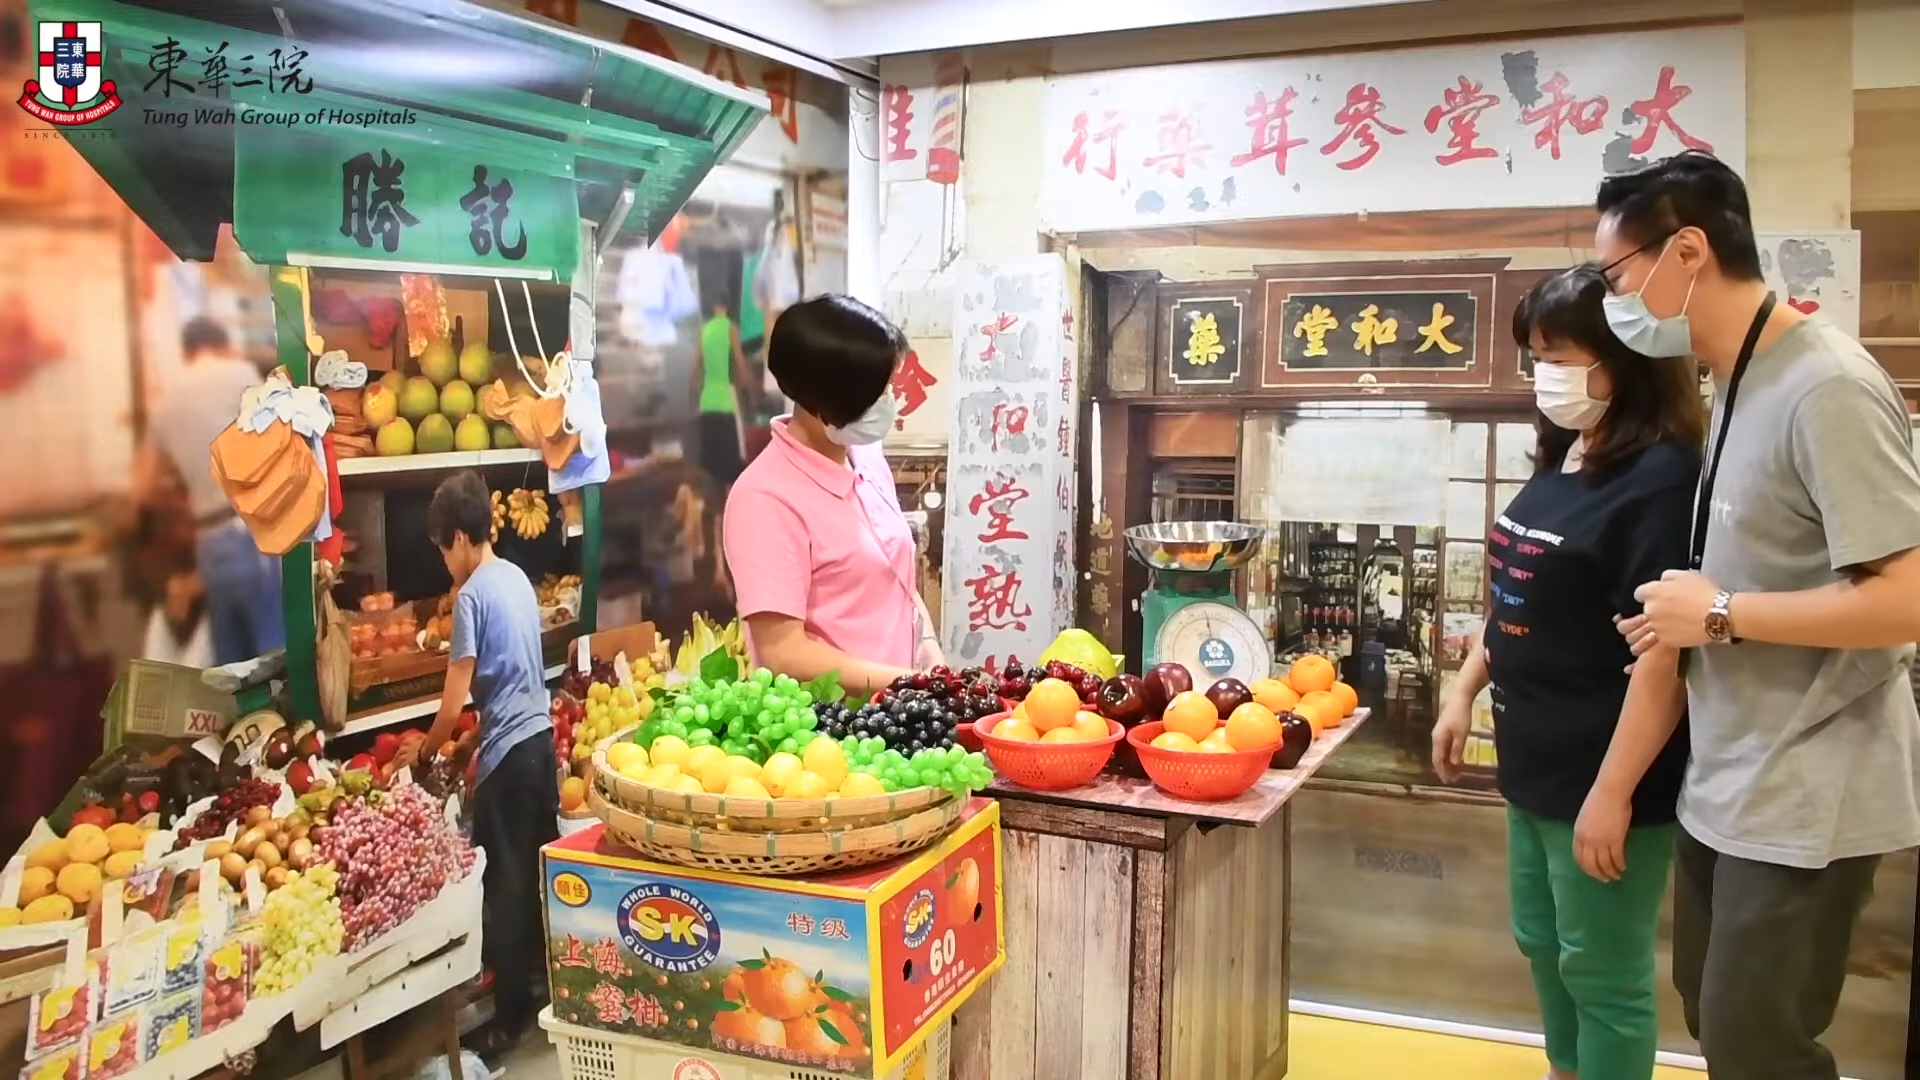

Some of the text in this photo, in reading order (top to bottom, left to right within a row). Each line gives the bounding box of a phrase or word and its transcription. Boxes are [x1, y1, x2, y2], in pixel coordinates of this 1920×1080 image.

[340, 148, 528, 260] 勝記
[1294, 302, 1463, 357] 大和堂
[621, 886, 713, 922] WHOLE WORLD
[637, 905, 698, 946] SK
[786, 912, 851, 940] 特级
[559, 932, 626, 980] 上海
[624, 935, 715, 972] GUARANTEE
[930, 928, 956, 976] 60
[593, 980, 663, 1028] 蜜柑
